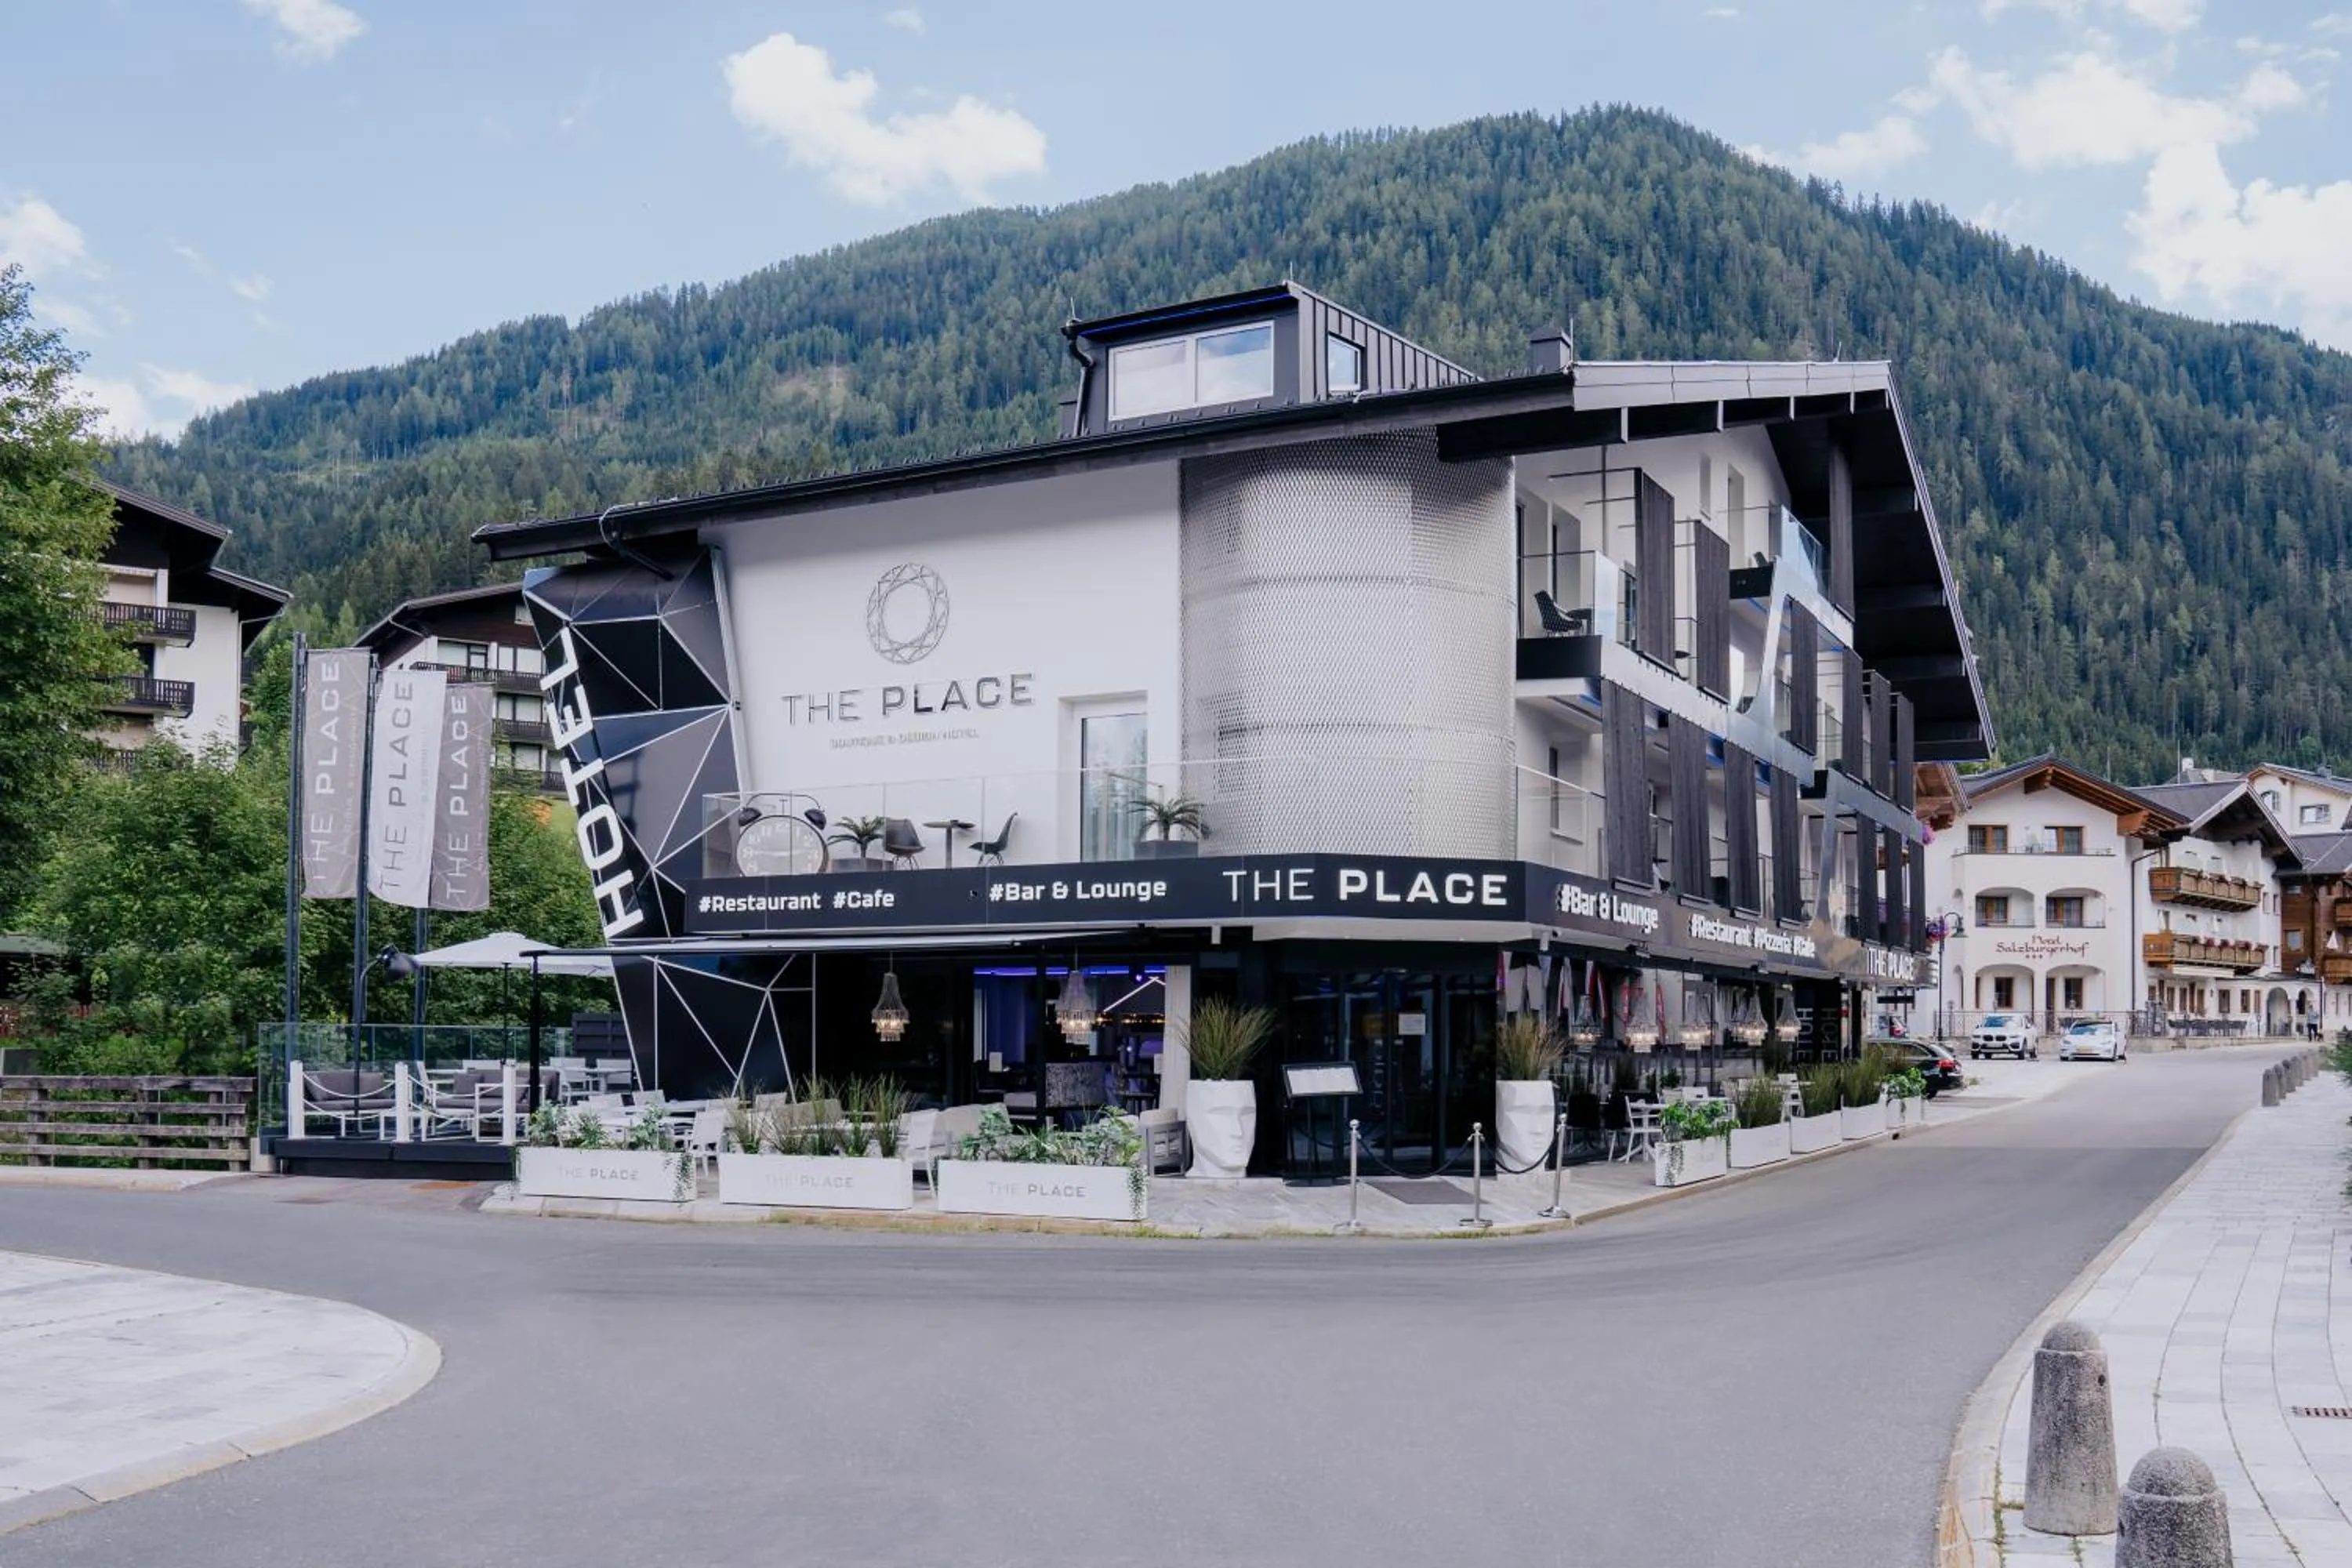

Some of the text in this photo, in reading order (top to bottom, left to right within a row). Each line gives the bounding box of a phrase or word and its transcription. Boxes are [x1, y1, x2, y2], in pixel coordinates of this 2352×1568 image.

[782, 673, 1033, 725] THE PLACE
[311, 661, 339, 880] THE PLACE
[379, 682, 412, 888] THE PLACE
[540, 626, 644, 939] HOTEL
[446, 695, 470, 899] THE PLACE
[699, 889, 895, 913] #Restaurant #Cafe
[989, 880, 1167, 902] #Bar & Lounge
[1222, 869, 1508, 906] THE PLACE
[1560, 884, 1659, 935] #Bar & Lounge
[1868, 946, 1887, 977] THE
[1996, 942, 2089, 959] Salzburgerhof
[557, 1167, 640, 1180] THE PLACE
[800, 1175, 855, 1188] PLACE
[988, 1181, 1087, 1197] THE PLACE
